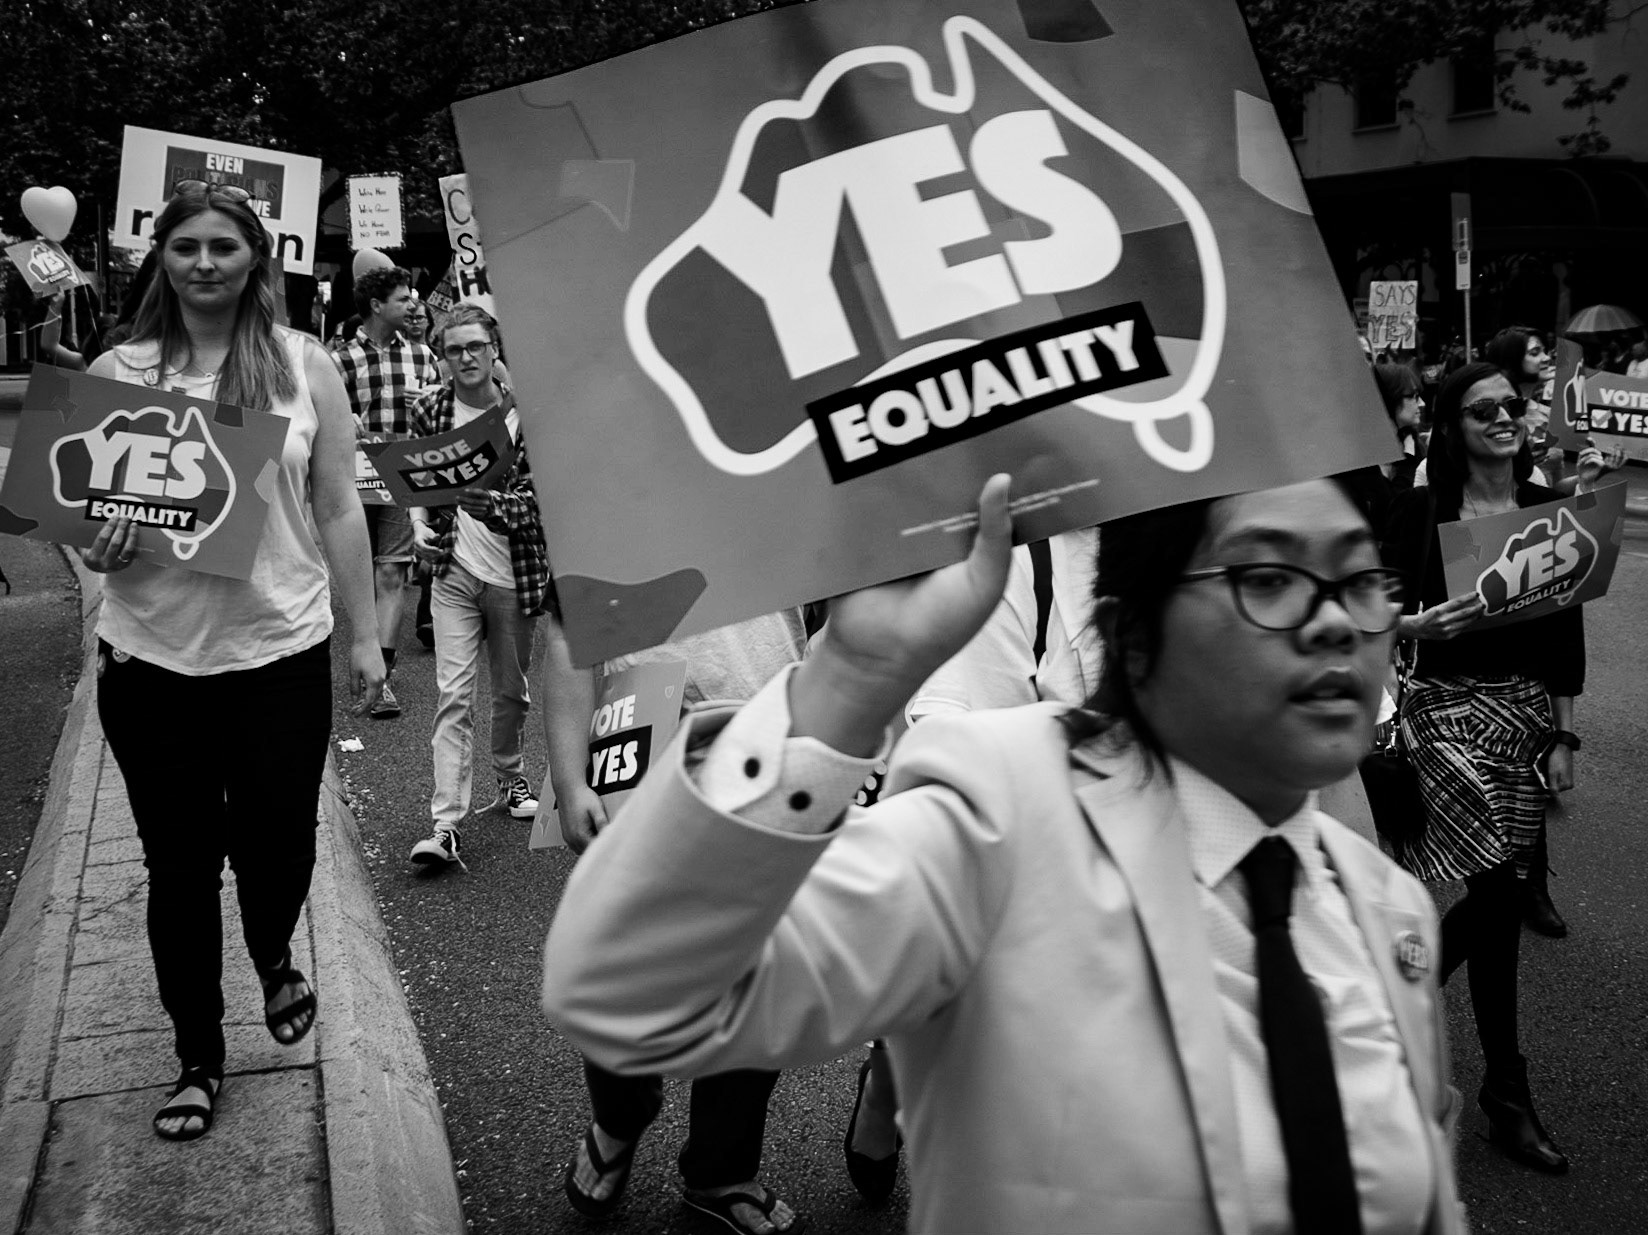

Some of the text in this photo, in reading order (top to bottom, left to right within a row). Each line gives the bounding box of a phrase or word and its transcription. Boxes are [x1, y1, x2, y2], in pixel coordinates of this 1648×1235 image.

[206, 153, 244, 175] EVEN
[695, 109, 1123, 381] YES
[1375, 284, 1416, 307] SAYS
[1369, 311, 1414, 343] YES
[829, 319, 1141, 463] EQUALITY
[83, 429, 207, 500] YES
[403, 438, 472, 468] VOTE
[437, 452, 490, 485] YES
[90, 500, 193, 528] EQUALITY
[1494, 529, 1580, 600] YES
[1506, 578, 1572, 613] EQUALITY
[591, 740, 639, 788] YES
